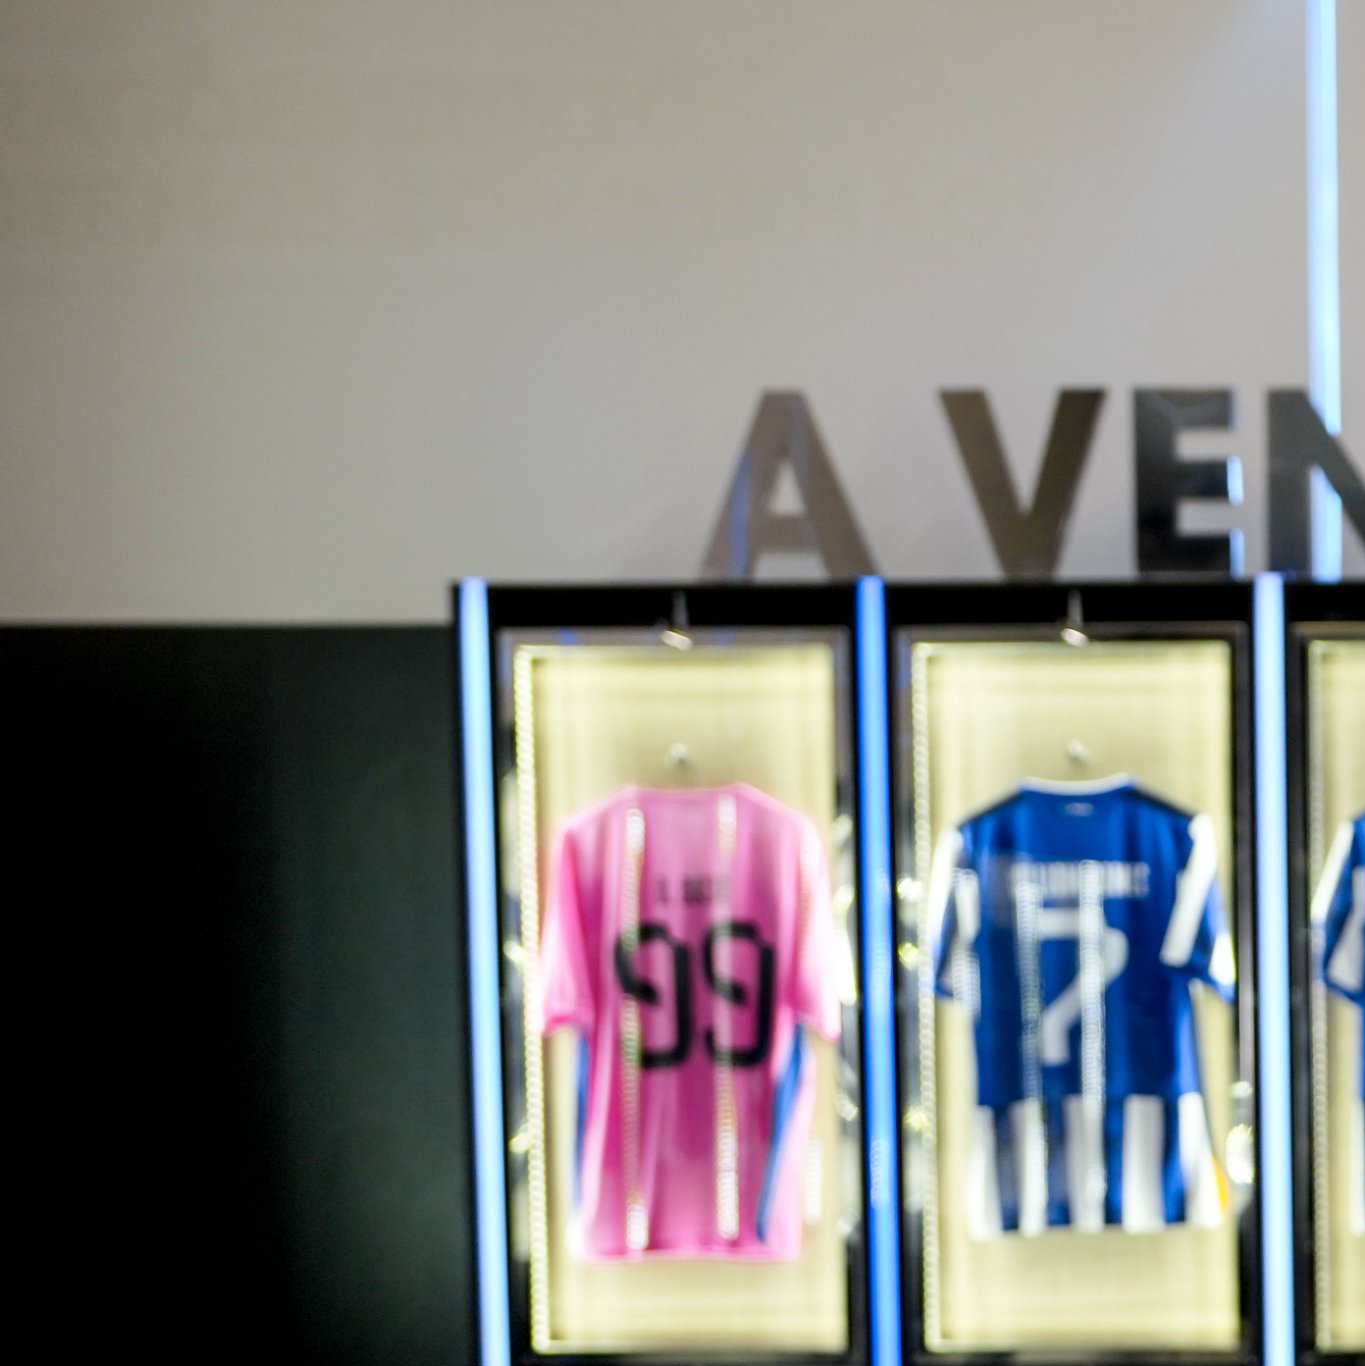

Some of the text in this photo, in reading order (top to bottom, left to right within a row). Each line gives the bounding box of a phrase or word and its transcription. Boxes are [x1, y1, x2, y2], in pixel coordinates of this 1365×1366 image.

[700, 386, 884, 580] A
[614, 919, 777, 1068] 99
[1022, 906, 1128, 1065] 7
